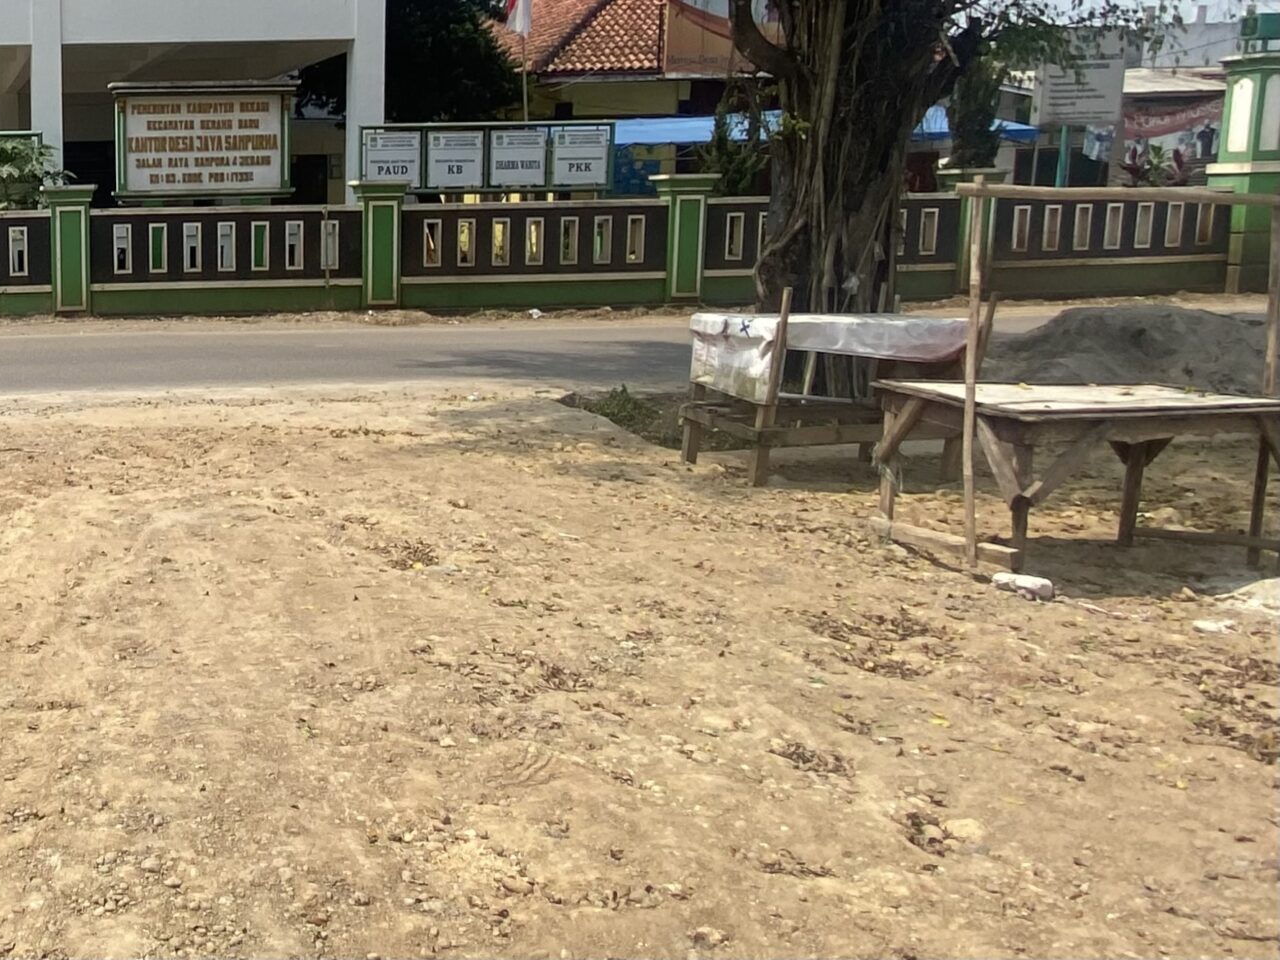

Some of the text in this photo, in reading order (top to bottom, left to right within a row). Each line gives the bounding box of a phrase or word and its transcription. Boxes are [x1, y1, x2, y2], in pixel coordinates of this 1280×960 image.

[128, 136, 168, 153] KANTOR
[168, 135, 194, 153] DESA
[136, 157, 162, 168] JALAN
[168, 157, 188, 168] RAYA
[568, 162, 592, 172] PKK
[377, 165, 409, 176] PAUD
[447, 164, 463, 175] KB
